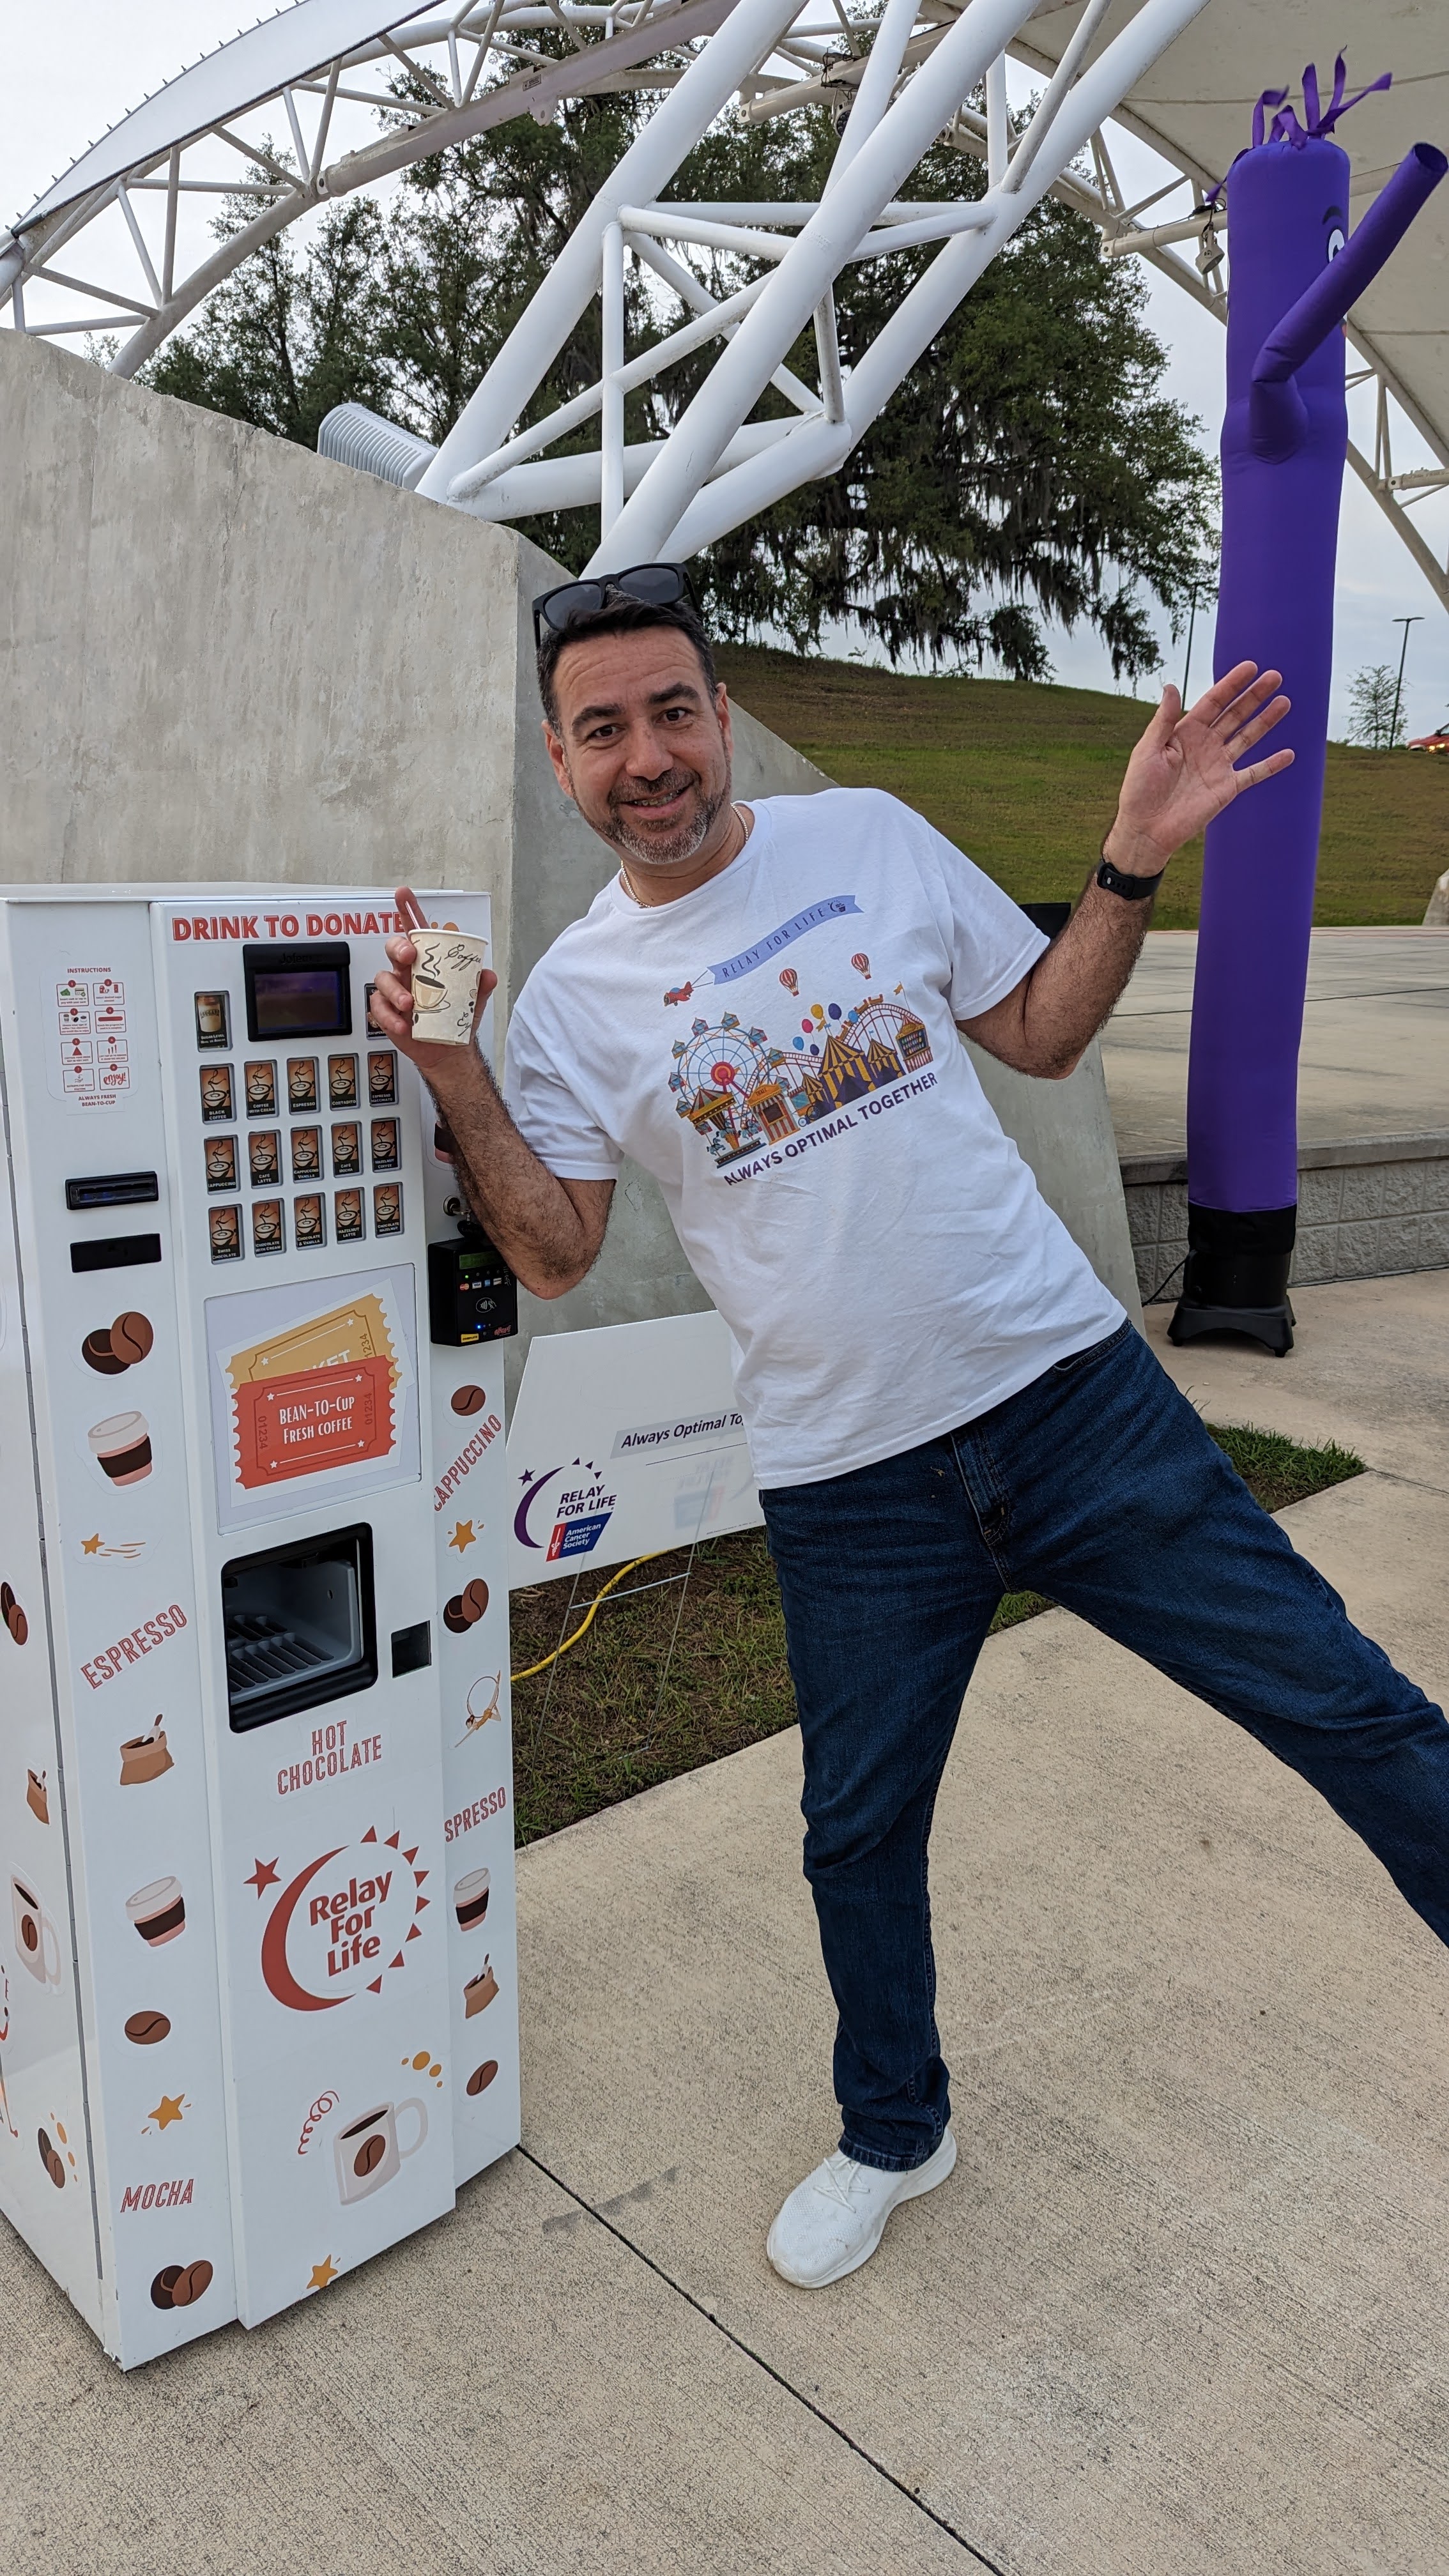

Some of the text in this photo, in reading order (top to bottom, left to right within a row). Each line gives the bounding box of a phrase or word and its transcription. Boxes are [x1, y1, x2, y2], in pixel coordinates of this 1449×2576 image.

[172, 916, 259, 941] DRINK
[264, 915, 299, 938] TO
[722, 908, 825, 977] RELAY FOR LIFE
[103, 1072, 126, 1085] enjoy!
[724, 1072, 938, 1186] ALWAYS OPTIMAL TOGETHER
[365, 1393, 373, 1425] 01234
[258, 1416, 268, 1449] 01234
[284, 1416, 353, 1444] FRESH COFFEE
[621, 1413, 744, 1449] Always Optimal To
[556, 1494, 617, 1518] FOR LIFE
[560, 1484, 606, 1505] RELAY
[563, 1538, 590, 1550] Society
[565, 1533, 590, 1542] Cancer
[566, 1524, 601, 1537] American
[80, 1604, 187, 1690] ESPRESSO
[312, 1720, 347, 1756] HOT
[277, 1735, 382, 1795] CHOCOLATE
[309, 1871, 392, 1926] Relay
[331, 1905, 376, 1945] For
[328, 1933, 381, 1977] Life
[120, 2179, 194, 2213] MOCHA
